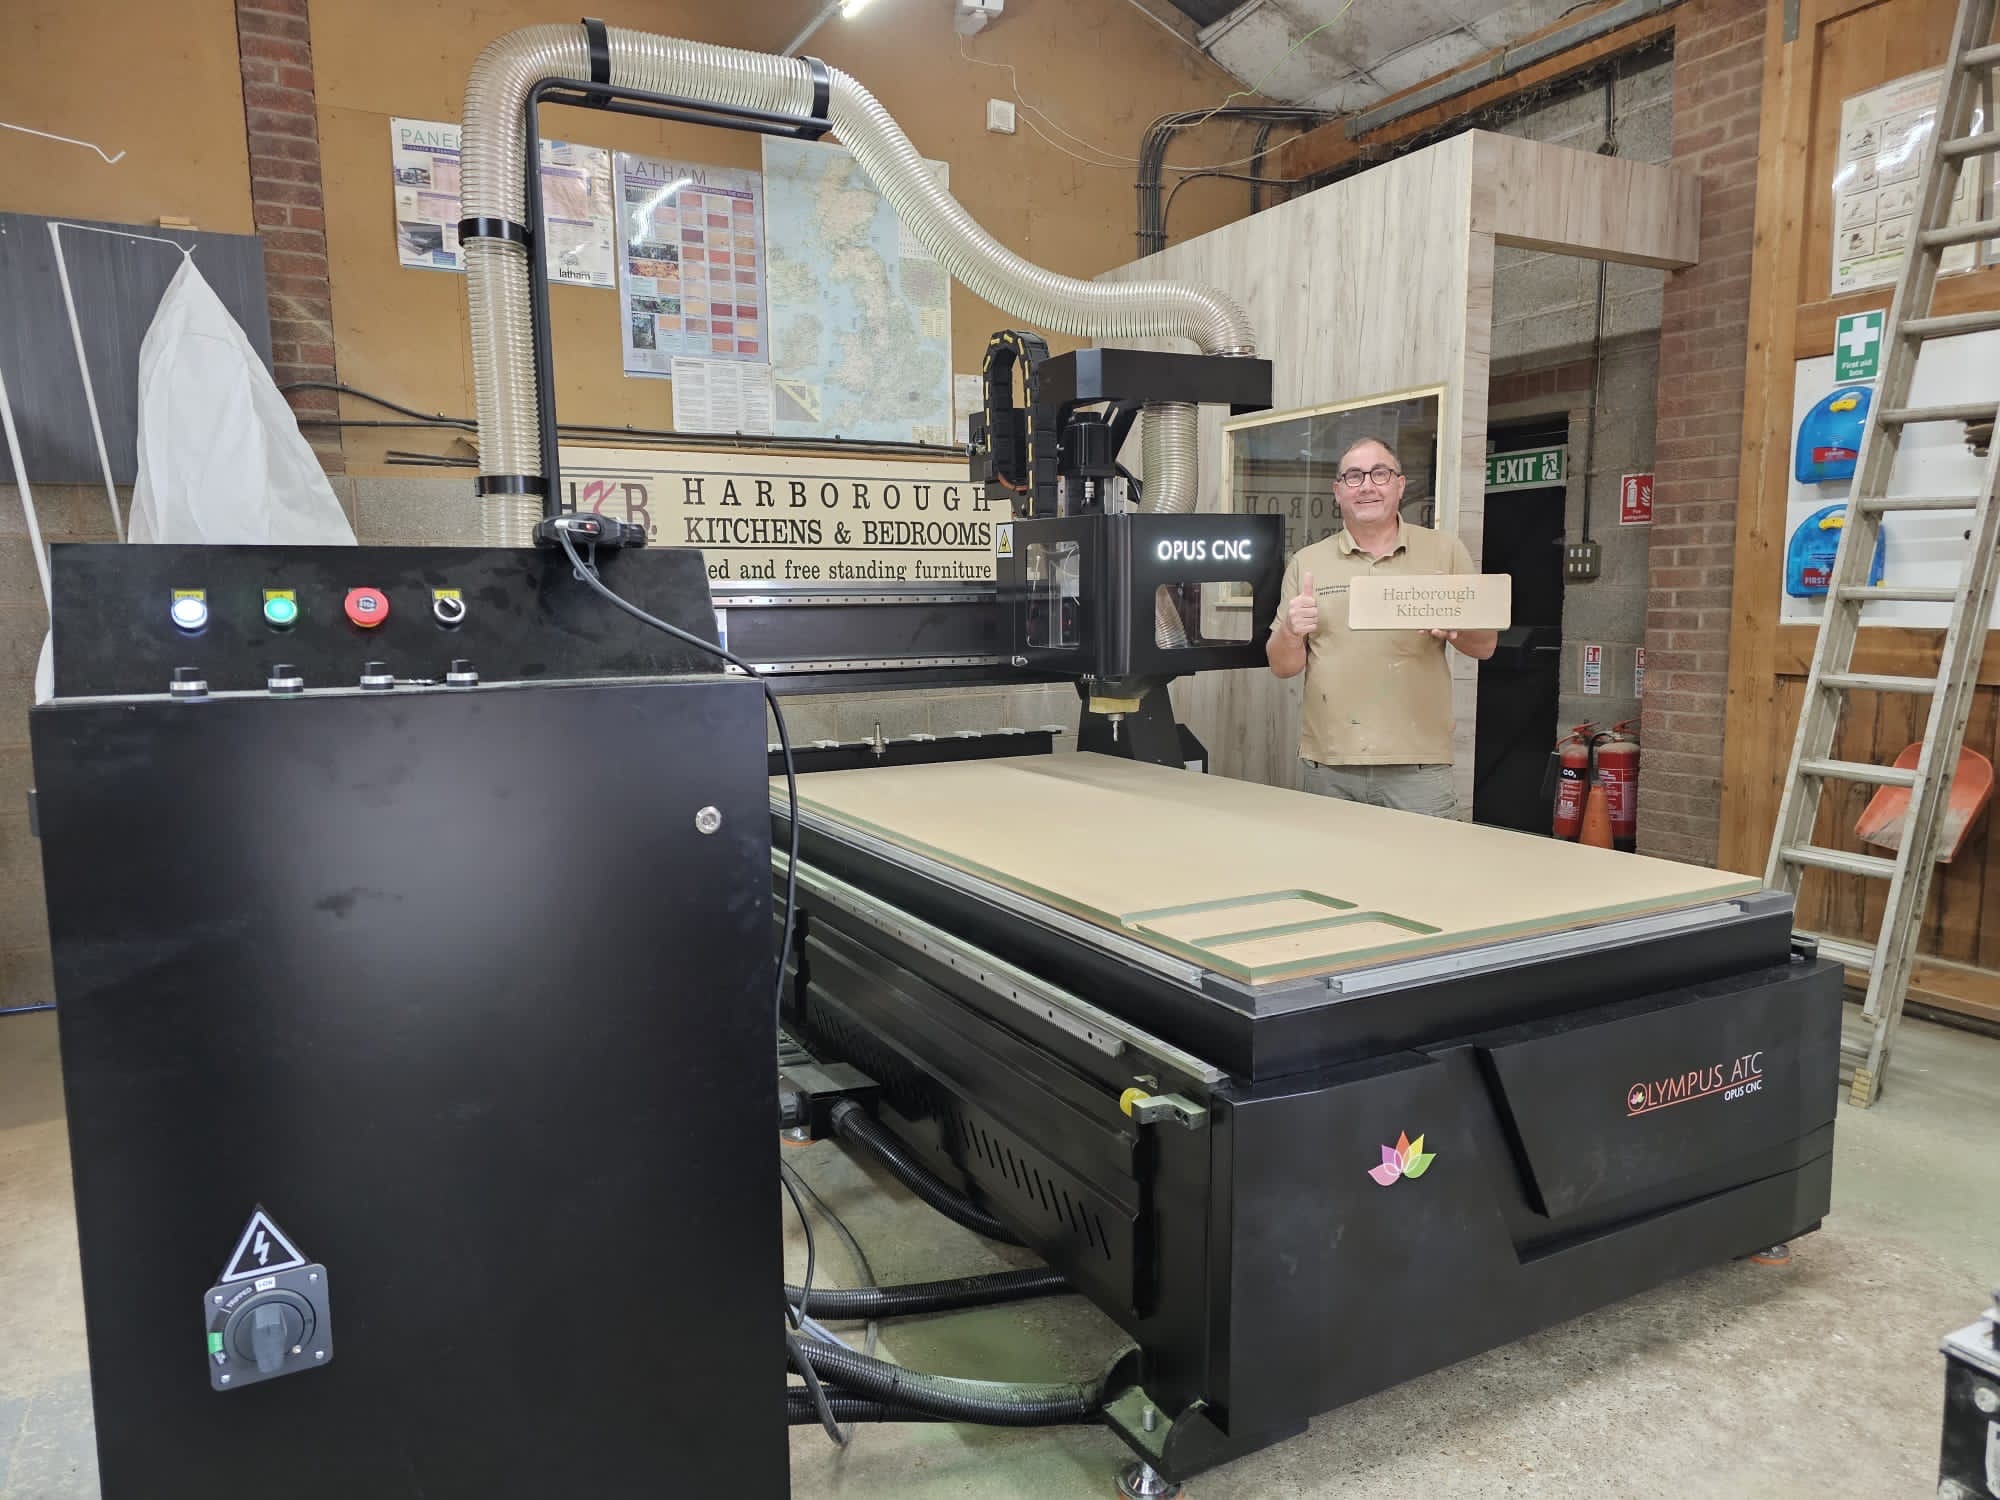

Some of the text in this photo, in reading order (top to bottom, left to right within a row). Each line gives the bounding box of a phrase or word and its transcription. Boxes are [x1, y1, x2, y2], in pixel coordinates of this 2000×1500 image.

[623, 160, 706, 185] LATHAM
[559, 267, 591, 280] latham
[1496, 456, 1537, 484] EXIT
[682, 477, 991, 512] HARBOROUGH
[683, 517, 991, 546] KITCHENS & BEDROOMS
[1157, 539, 1252, 561] OPUS CNC
[708, 558, 991, 582] ed and free standing furniture
[1383, 586, 1476, 603] Harborough
[1396, 603, 1462, 617] Kitchens
[1627, 1051, 1764, 1111] OLYMPUS ATC
[1724, 1079, 1763, 1101] OPUS CNC
